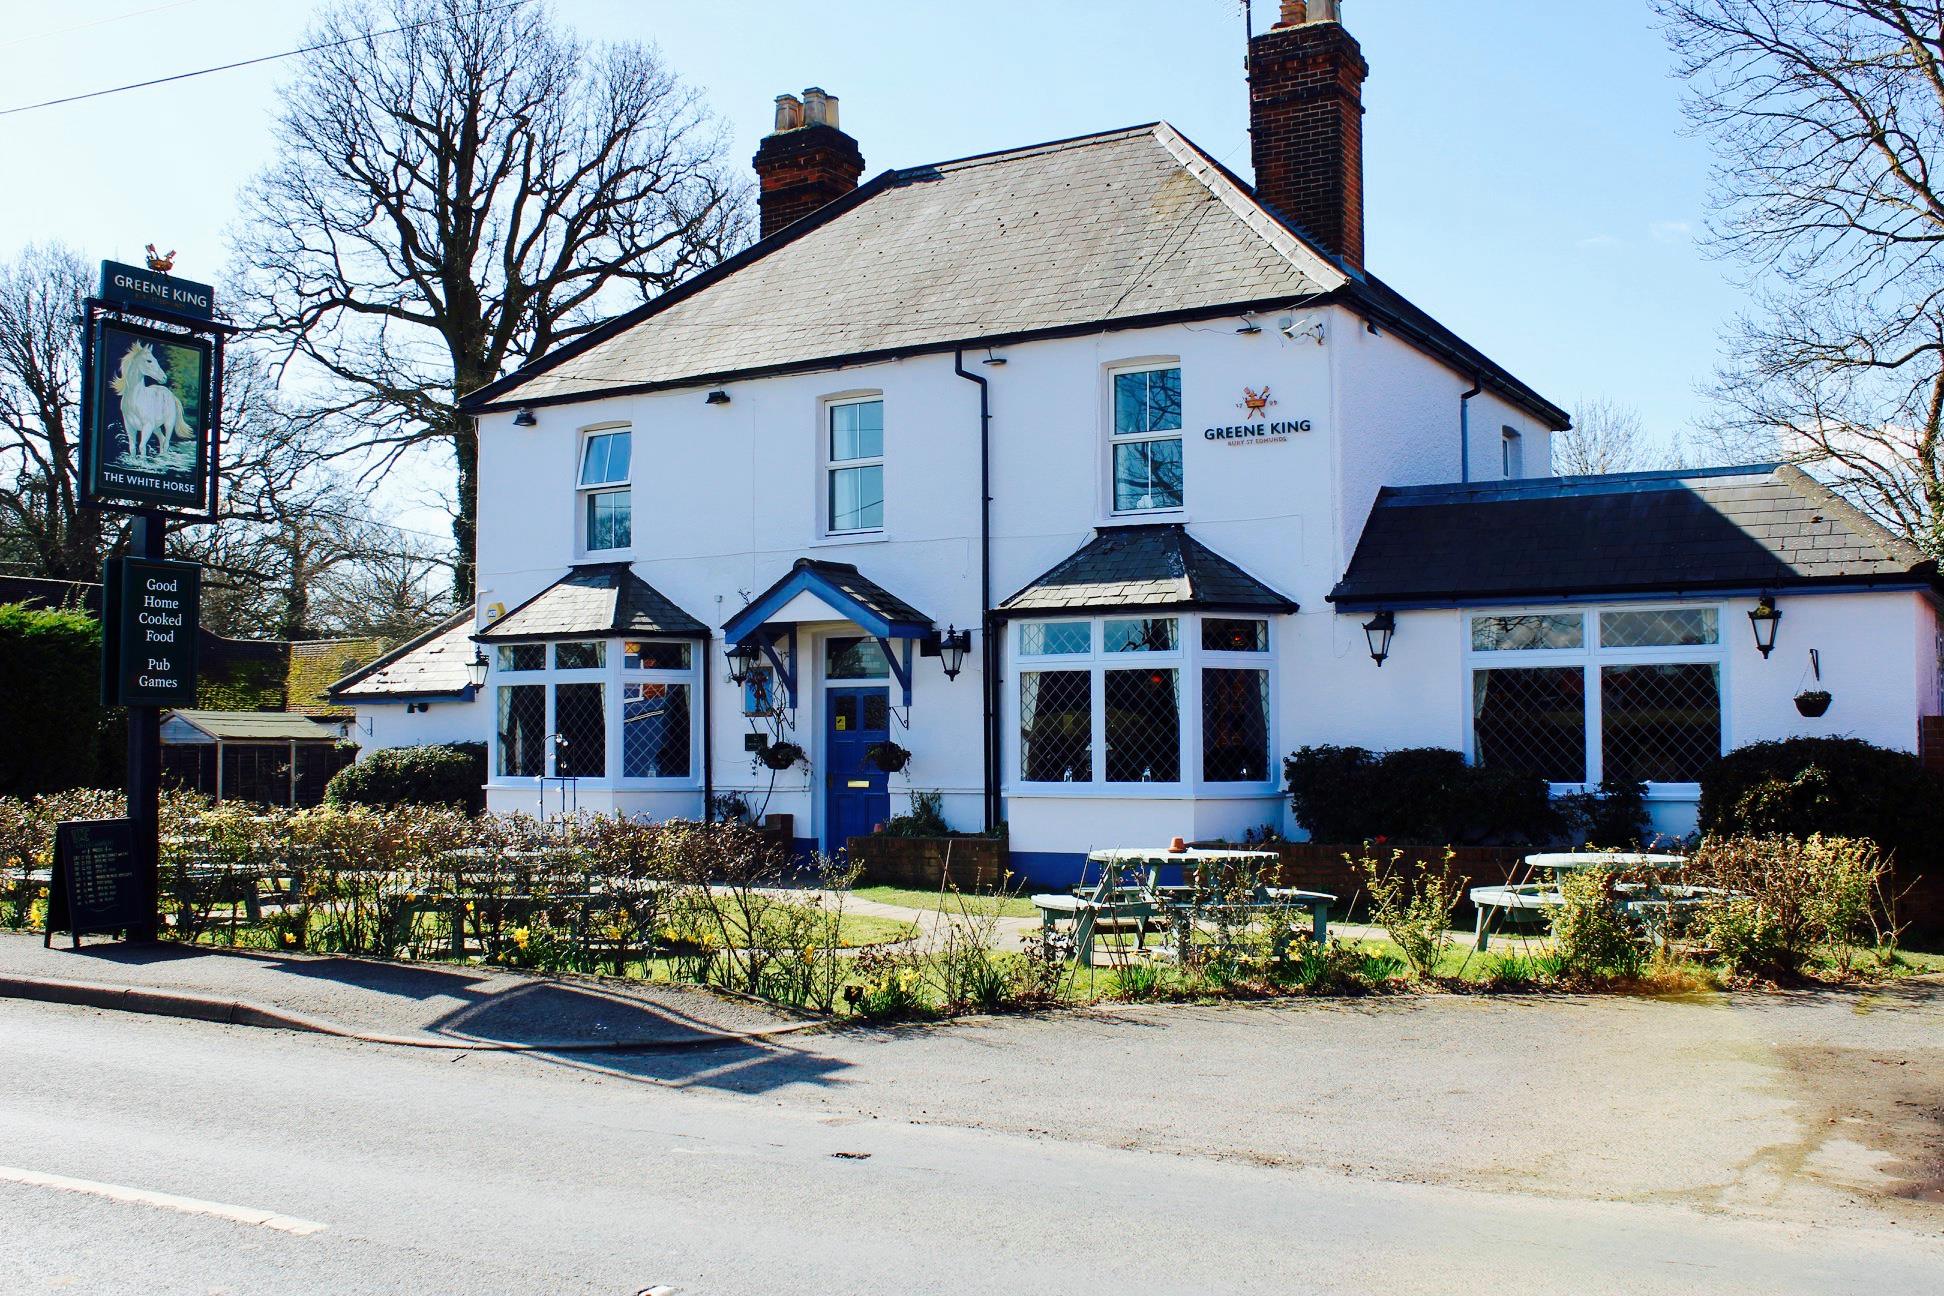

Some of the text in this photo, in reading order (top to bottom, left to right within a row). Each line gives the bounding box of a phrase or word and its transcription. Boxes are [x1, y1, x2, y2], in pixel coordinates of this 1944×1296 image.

[114, 275, 169, 298] GREENE
[173, 288, 207, 307] KING
[1204, 420, 1311, 440] GREENE KING
[104, 472, 195, 493] THE WHITE HORSE
[146, 578, 177, 592] Good
[144, 595, 179, 609] Home
[138, 612, 182, 626] Cooked
[145, 629, 174, 643] Food
[148, 658, 171, 671] Pub
[138, 675, 178, 688] Games
